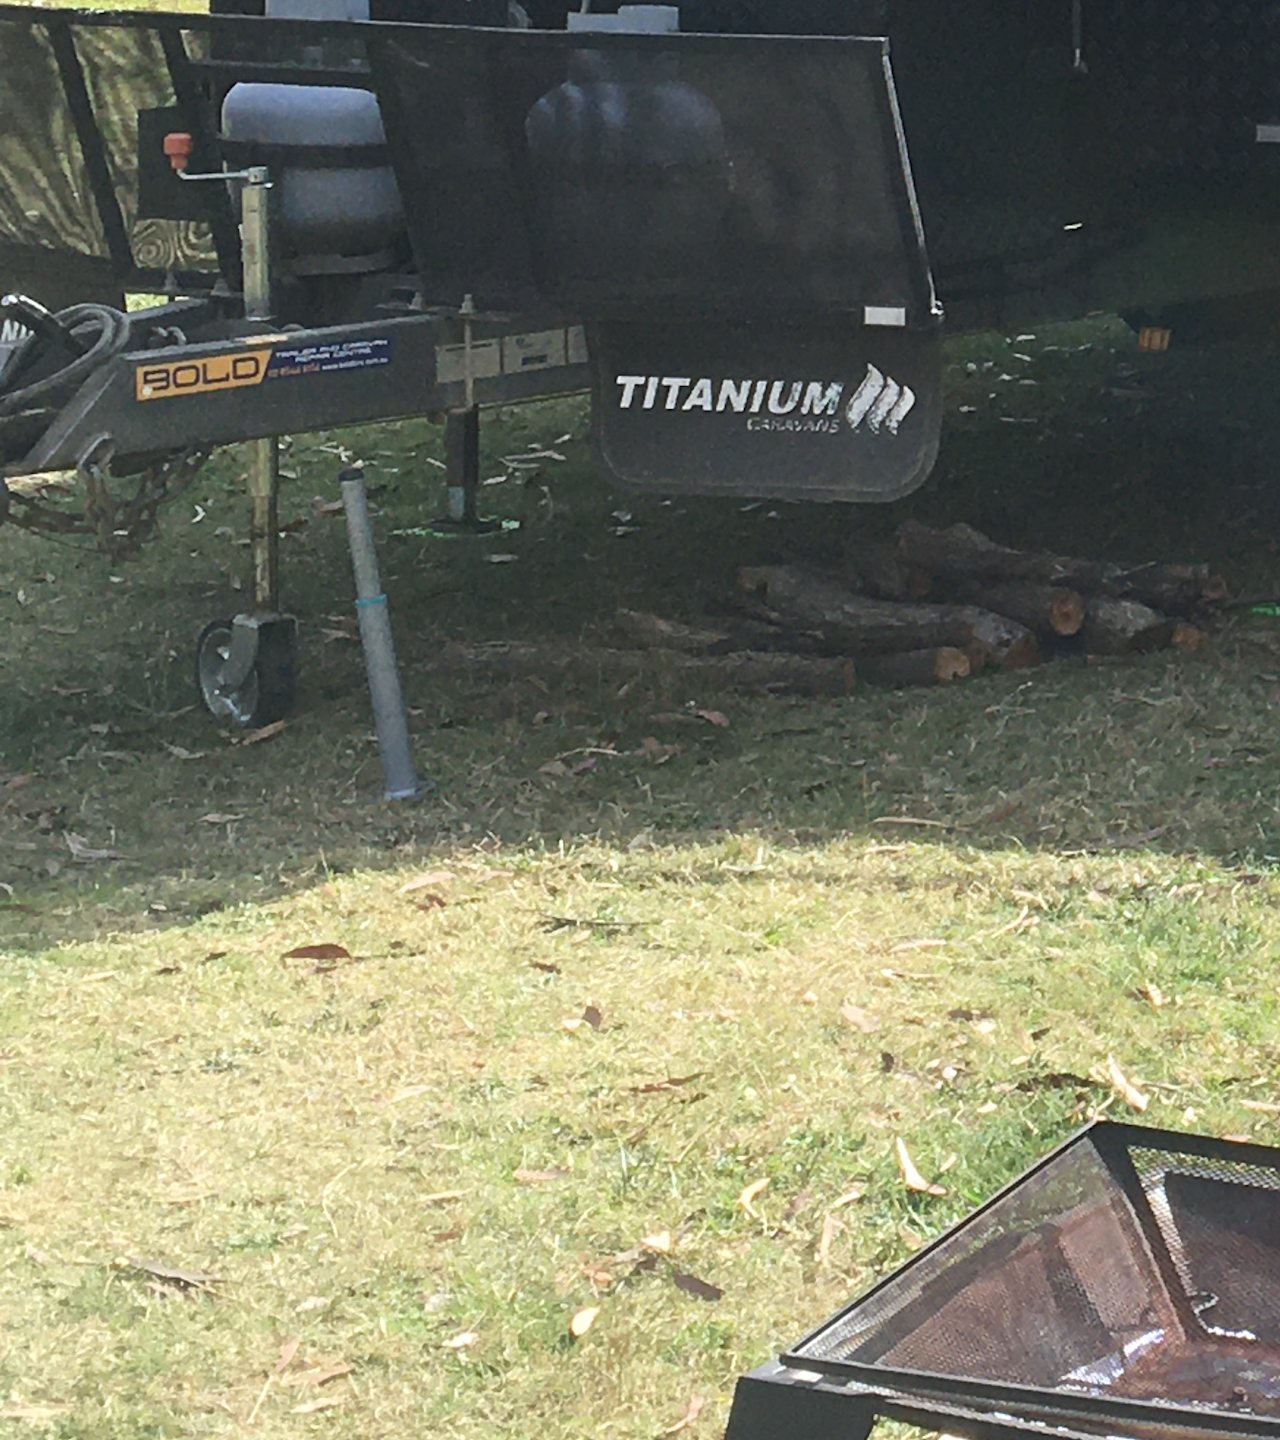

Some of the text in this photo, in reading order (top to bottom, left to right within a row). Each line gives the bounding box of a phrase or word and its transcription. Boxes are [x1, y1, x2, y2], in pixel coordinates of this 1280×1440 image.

[143, 356, 260, 391] BOLD
[616, 375, 844, 416] TITANIUM
[747, 417, 840, 433] CARAVANS
